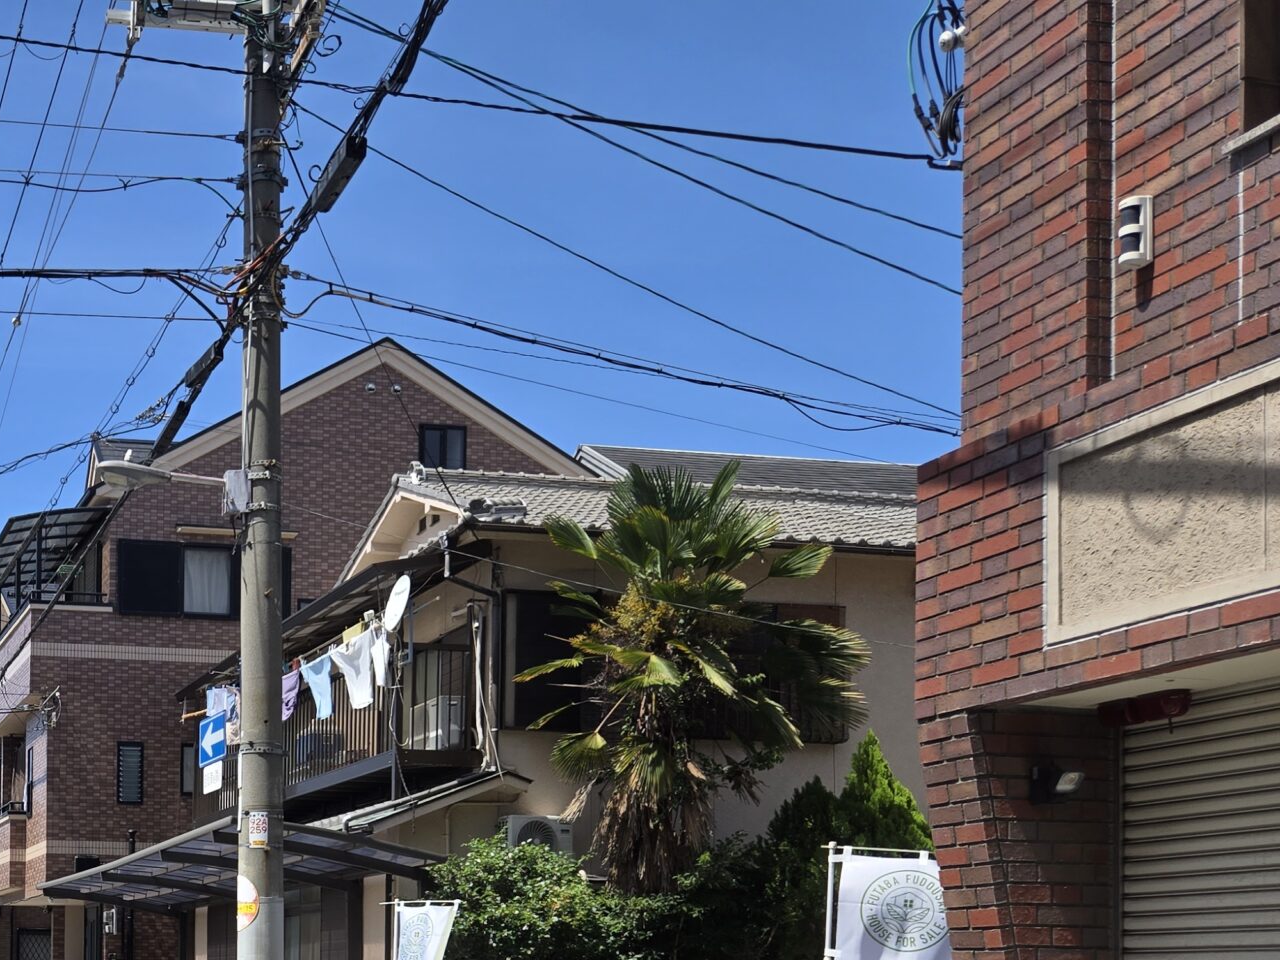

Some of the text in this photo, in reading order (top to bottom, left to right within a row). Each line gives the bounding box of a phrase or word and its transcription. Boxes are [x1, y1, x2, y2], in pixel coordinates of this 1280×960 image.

[250, 826, 267, 834] 259
[867, 876, 900, 907] FUTABA
[866, 914, 946, 948] HOUSE FOR SALE
